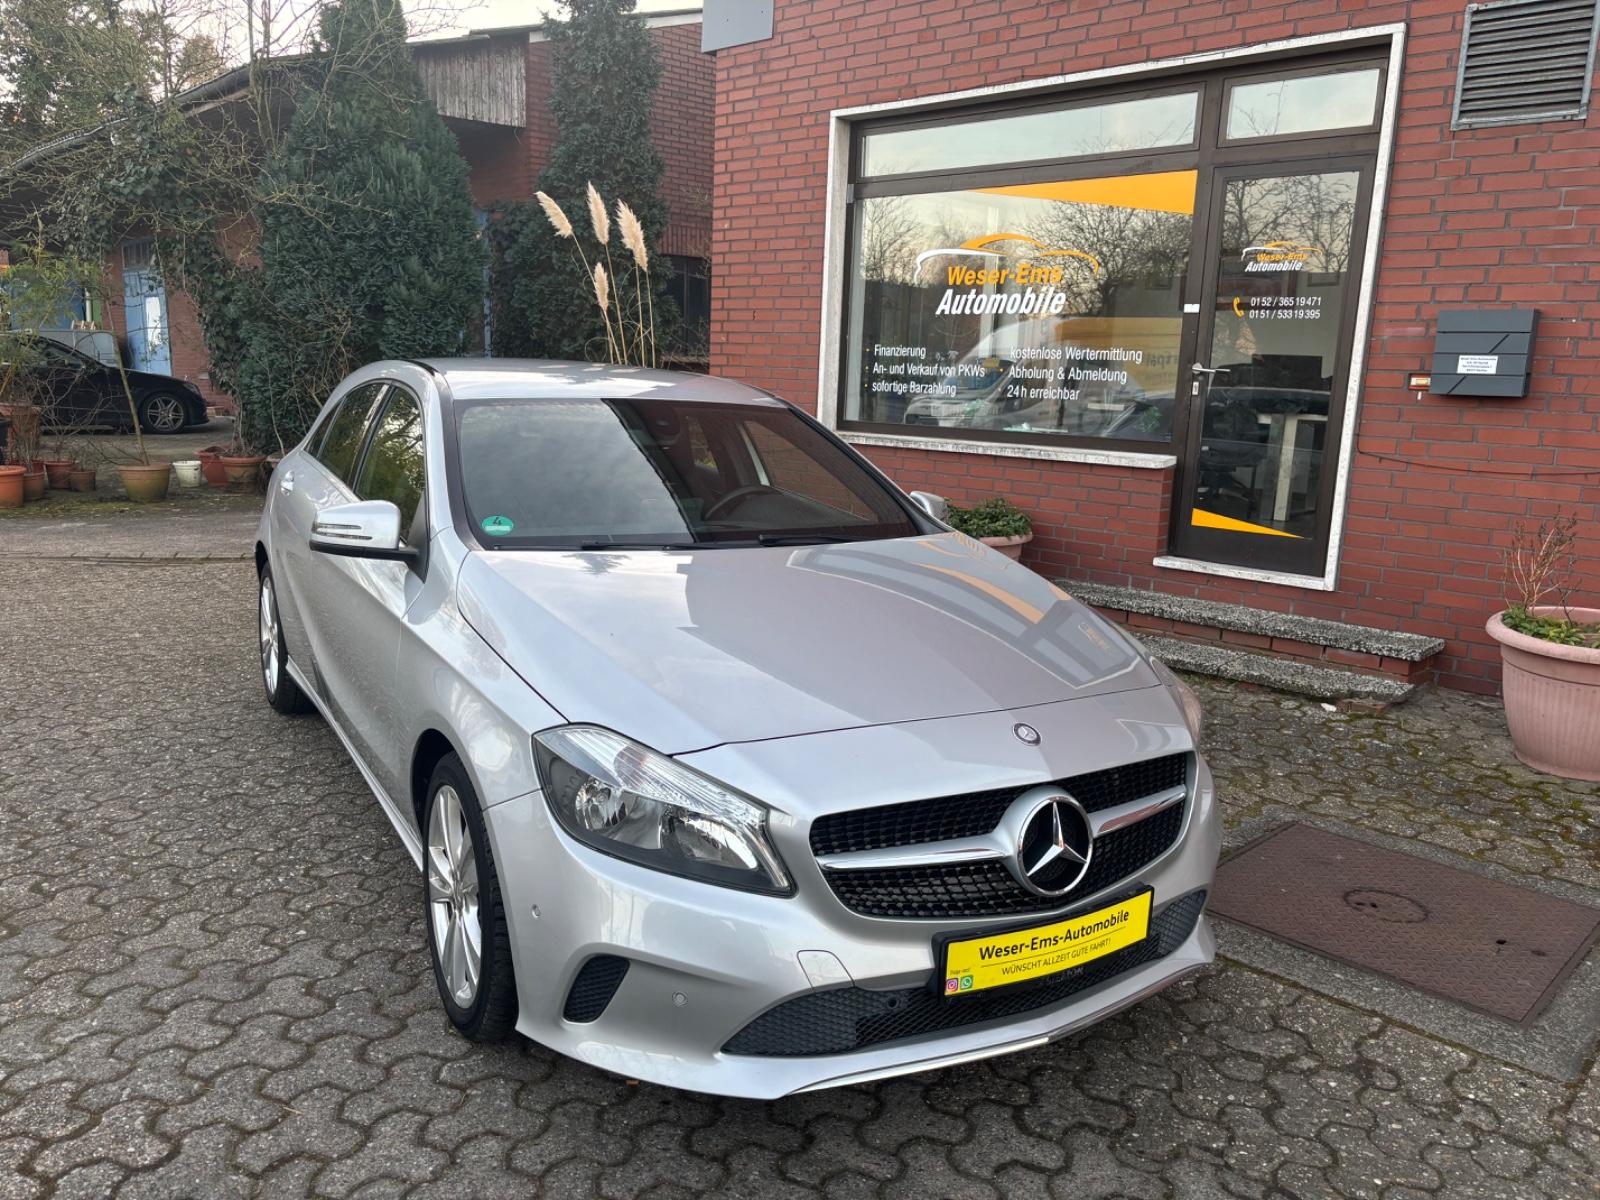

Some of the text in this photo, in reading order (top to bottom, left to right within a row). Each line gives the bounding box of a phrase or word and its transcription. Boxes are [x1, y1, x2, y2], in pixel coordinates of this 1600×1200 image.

[948, 262, 1063, 286] Weser-Ems
[1245, 260, 1303, 272] Automobile
[935, 286, 1067, 315] Automobile
[1250, 296, 1272, 307] 0152
[1249, 309, 1270, 319] 0151
[874, 344, 926, 359] Finanzierung
[1010, 346, 1062, 359] kostenlose
[1065, 346, 1143, 364] Wertermittlung
[873, 362, 985, 377] An- und Verkauf von PKWs
[1008, 366, 1127, 384] Abholung & Abmeldung
[872, 380, 957, 397] sofortige Barzahlung
[1029, 386, 1080, 400] erreichbar
[492, 516, 502, 526] 4
[979, 910, 1129, 960] Weser-Ems-Automobile
[1001, 959, 1041, 975] WÜNSCHT
[1042, 951, 1071, 967] ALLZEIT
[1071, 945, 1089, 958] GUTE
[1089, 937, 1111, 953] FAHRT!
